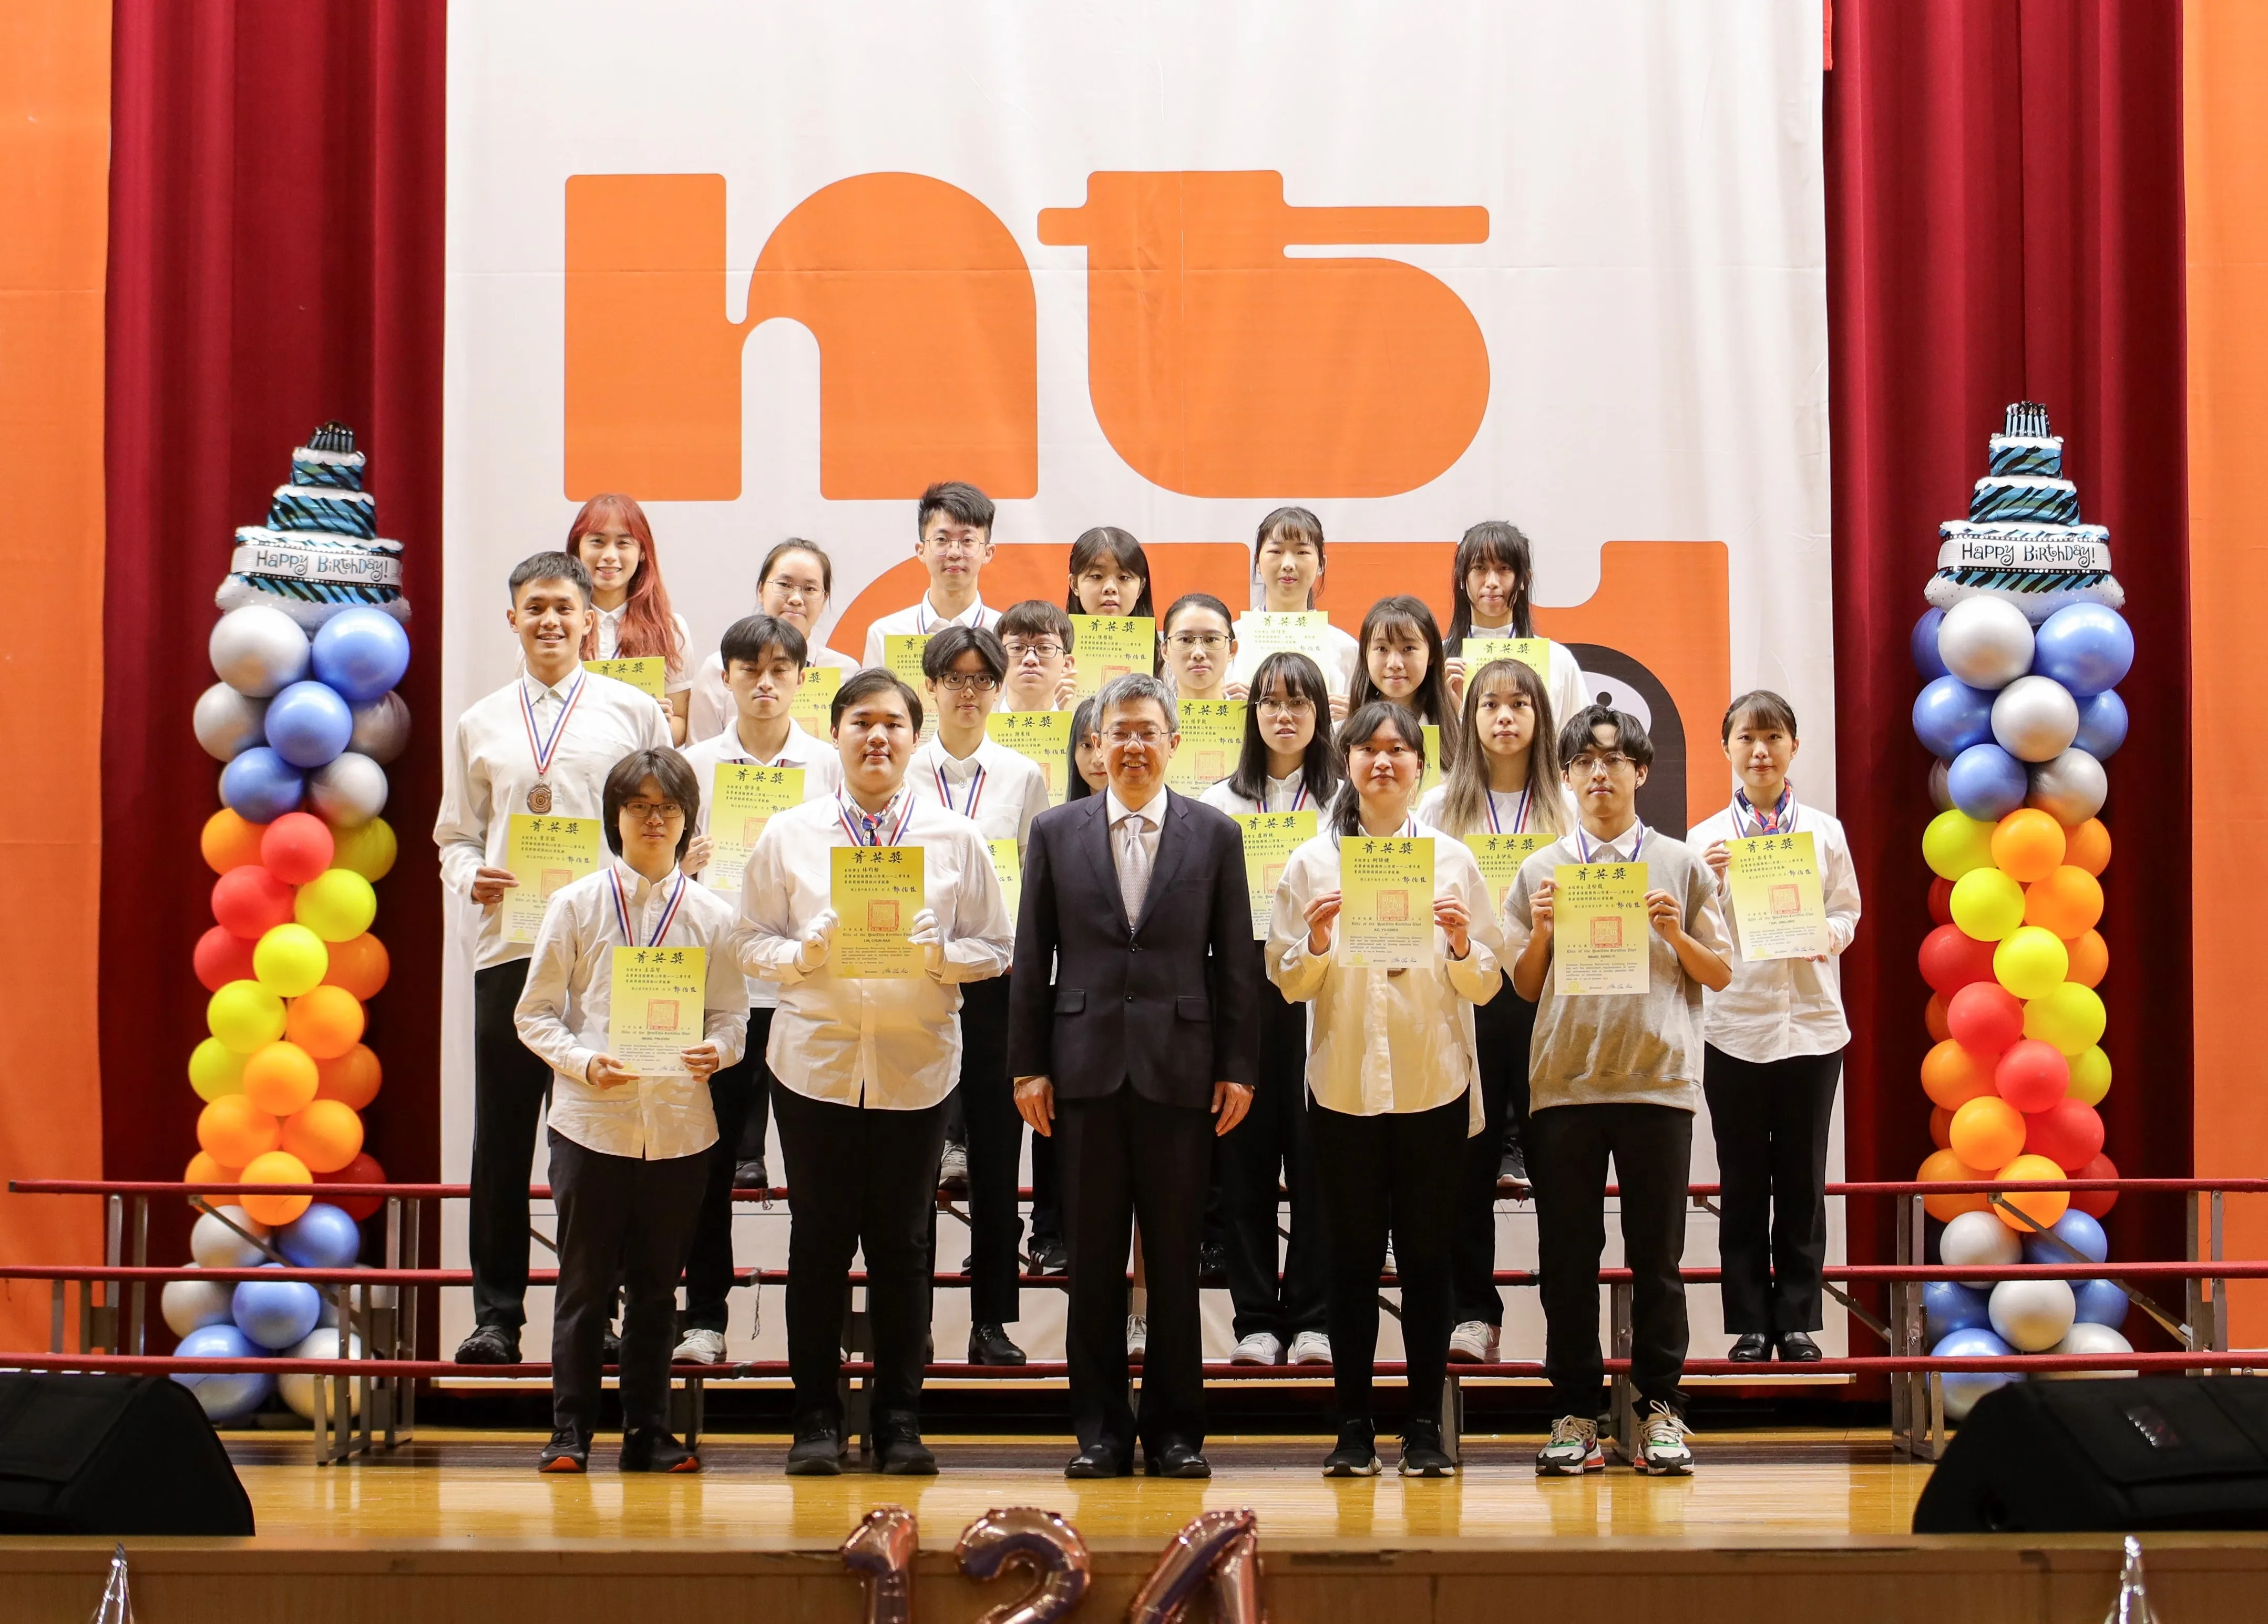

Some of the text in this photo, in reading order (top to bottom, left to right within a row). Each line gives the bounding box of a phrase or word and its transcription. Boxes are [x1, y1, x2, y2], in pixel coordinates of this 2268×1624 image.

[1962, 543, 2014, 566] Happy
[256, 550, 309, 576] Happy
[1089, 619, 1135, 633] 菁英獎
[1484, 642, 1530, 653] 菁英獎
[1182, 703, 1229, 716] 菁英獎
[1005, 715, 1052, 728] 菁英獎
[736, 769, 784, 784] 菁英獎
[530, 819, 579, 835] 菁英獎
[1247, 816, 1296, 830] 菁英獎
[1362, 840, 1413, 854] 菁英獎
[1486, 838, 1534, 850] 菁英獎
[1746, 838, 1793, 853] 菁英獎
[852, 850, 902, 864] 菁英獎
[1576, 867, 1627, 880] 菁英獎
[634, 951, 684, 964] 菁英獎
